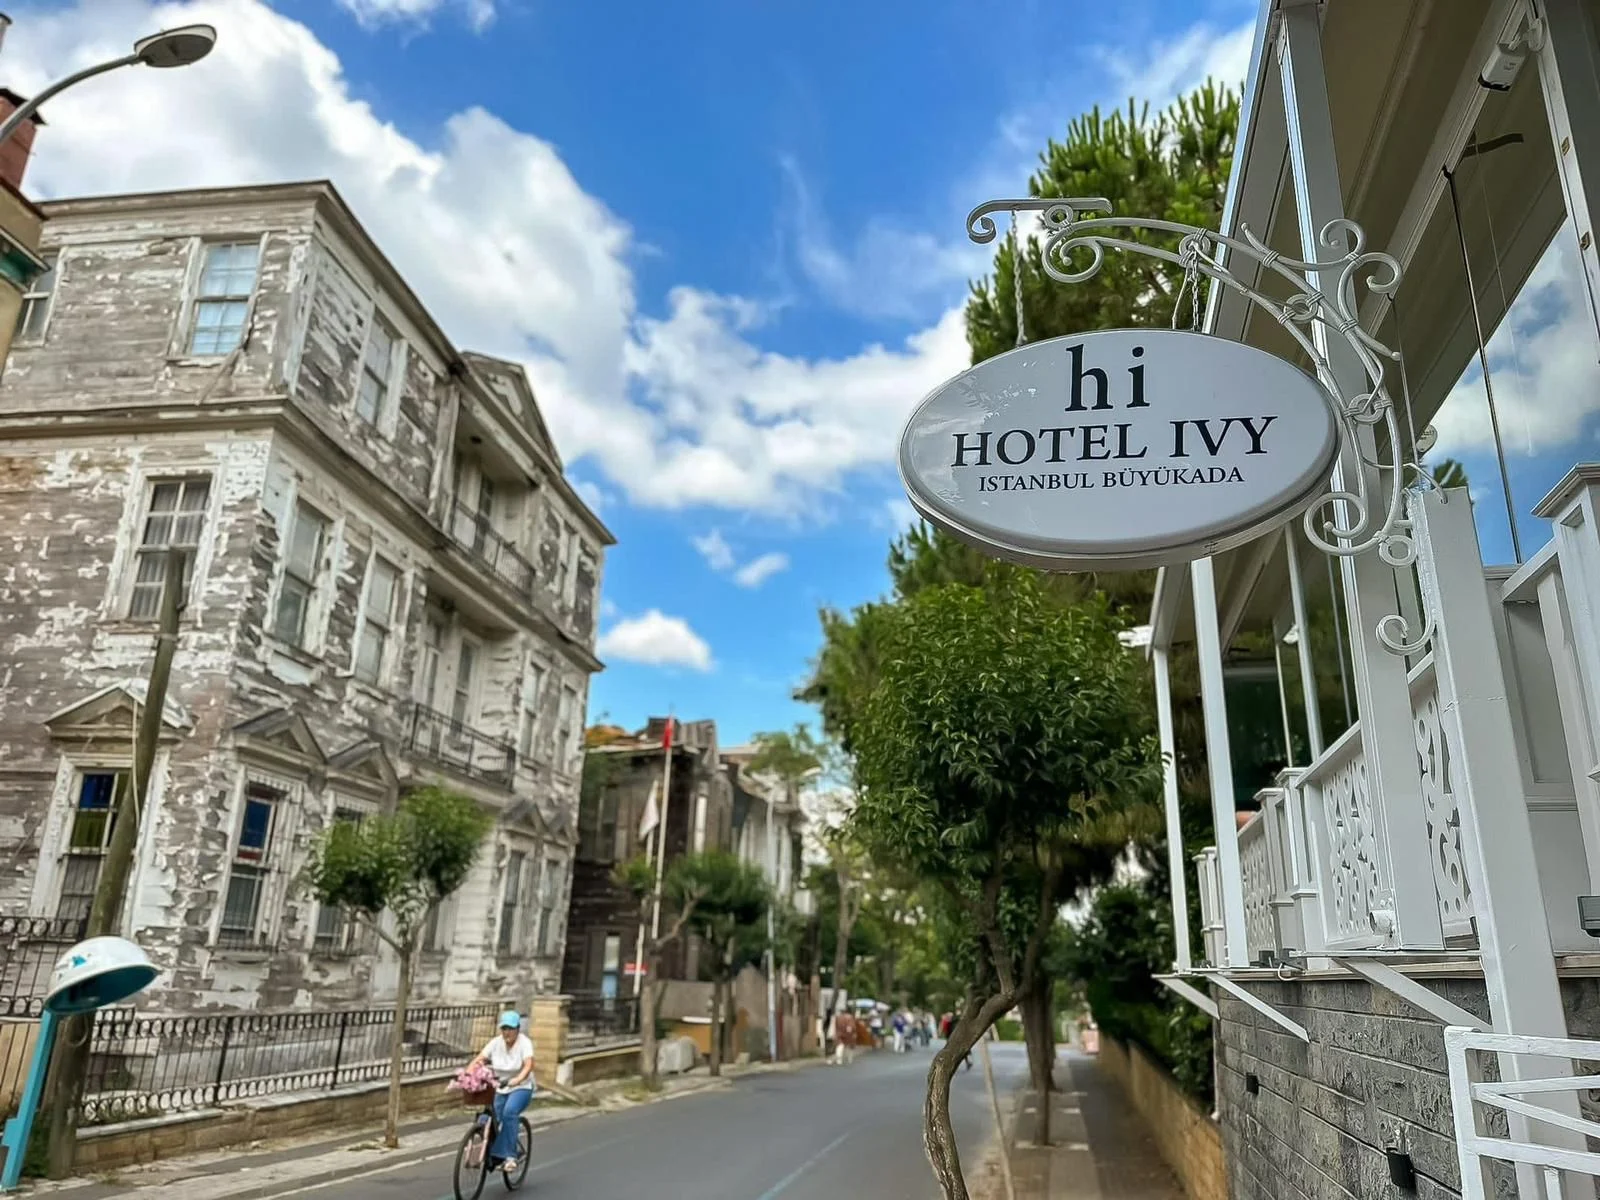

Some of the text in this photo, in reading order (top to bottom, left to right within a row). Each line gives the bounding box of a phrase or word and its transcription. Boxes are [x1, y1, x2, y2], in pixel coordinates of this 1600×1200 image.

[1065, 343, 1151, 412] hi
[950, 415, 1279, 468] HOTEL IVY
[978, 465, 1245, 492] ISTANBUL BÜYÜKADA
